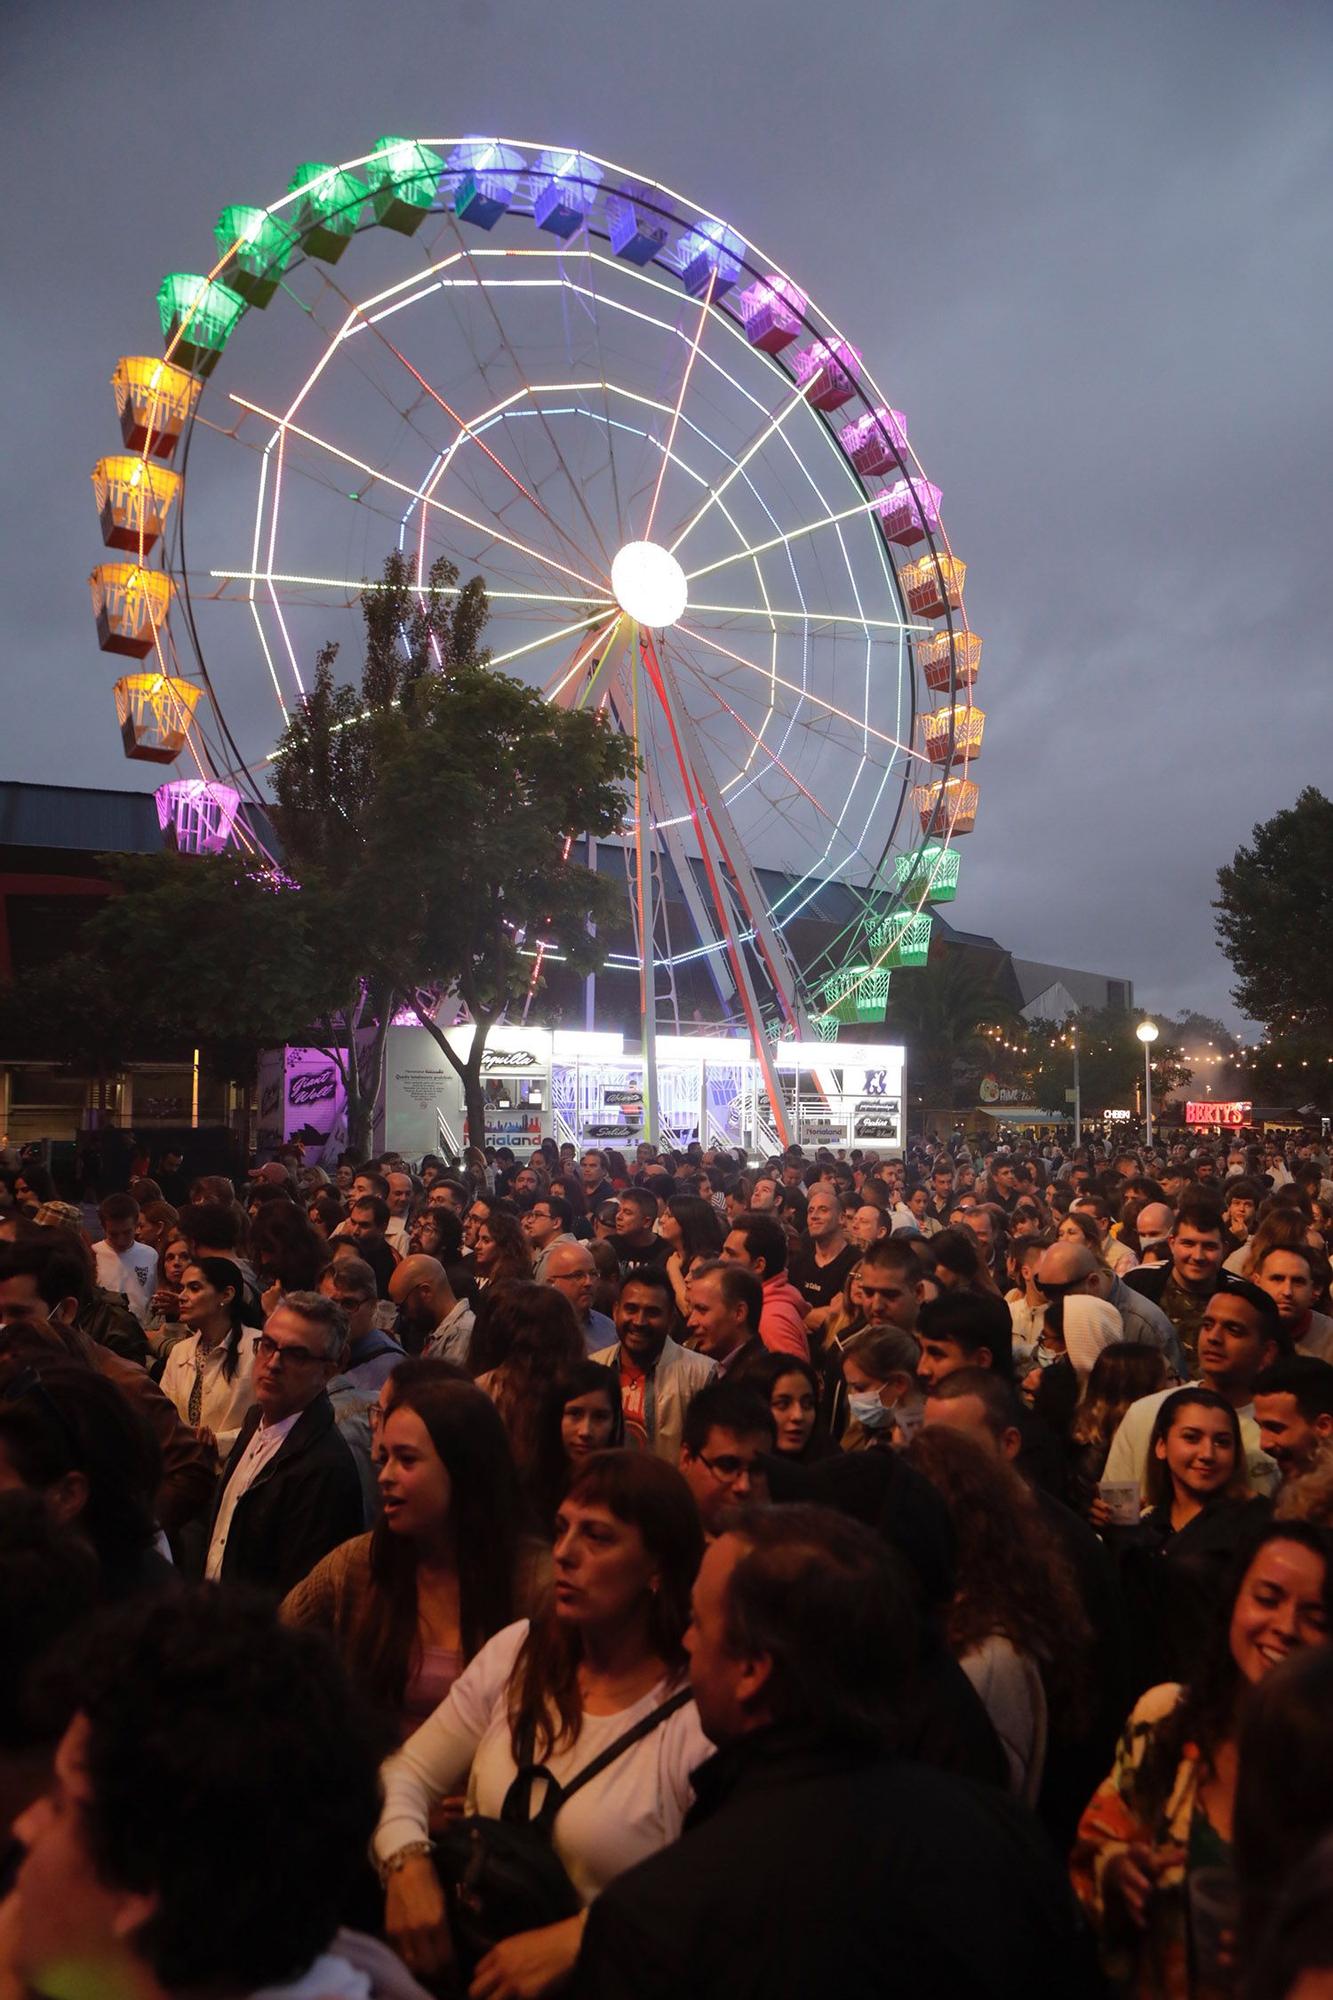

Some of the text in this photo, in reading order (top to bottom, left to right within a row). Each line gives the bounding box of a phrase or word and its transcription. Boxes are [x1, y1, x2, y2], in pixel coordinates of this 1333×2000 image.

[481, 1051, 534, 1070] Taquilla
[291, 1071, 332, 1098] Giant
[596, 1127, 631, 1137] Salida
[463, 1134, 542, 1146] Nrialand
